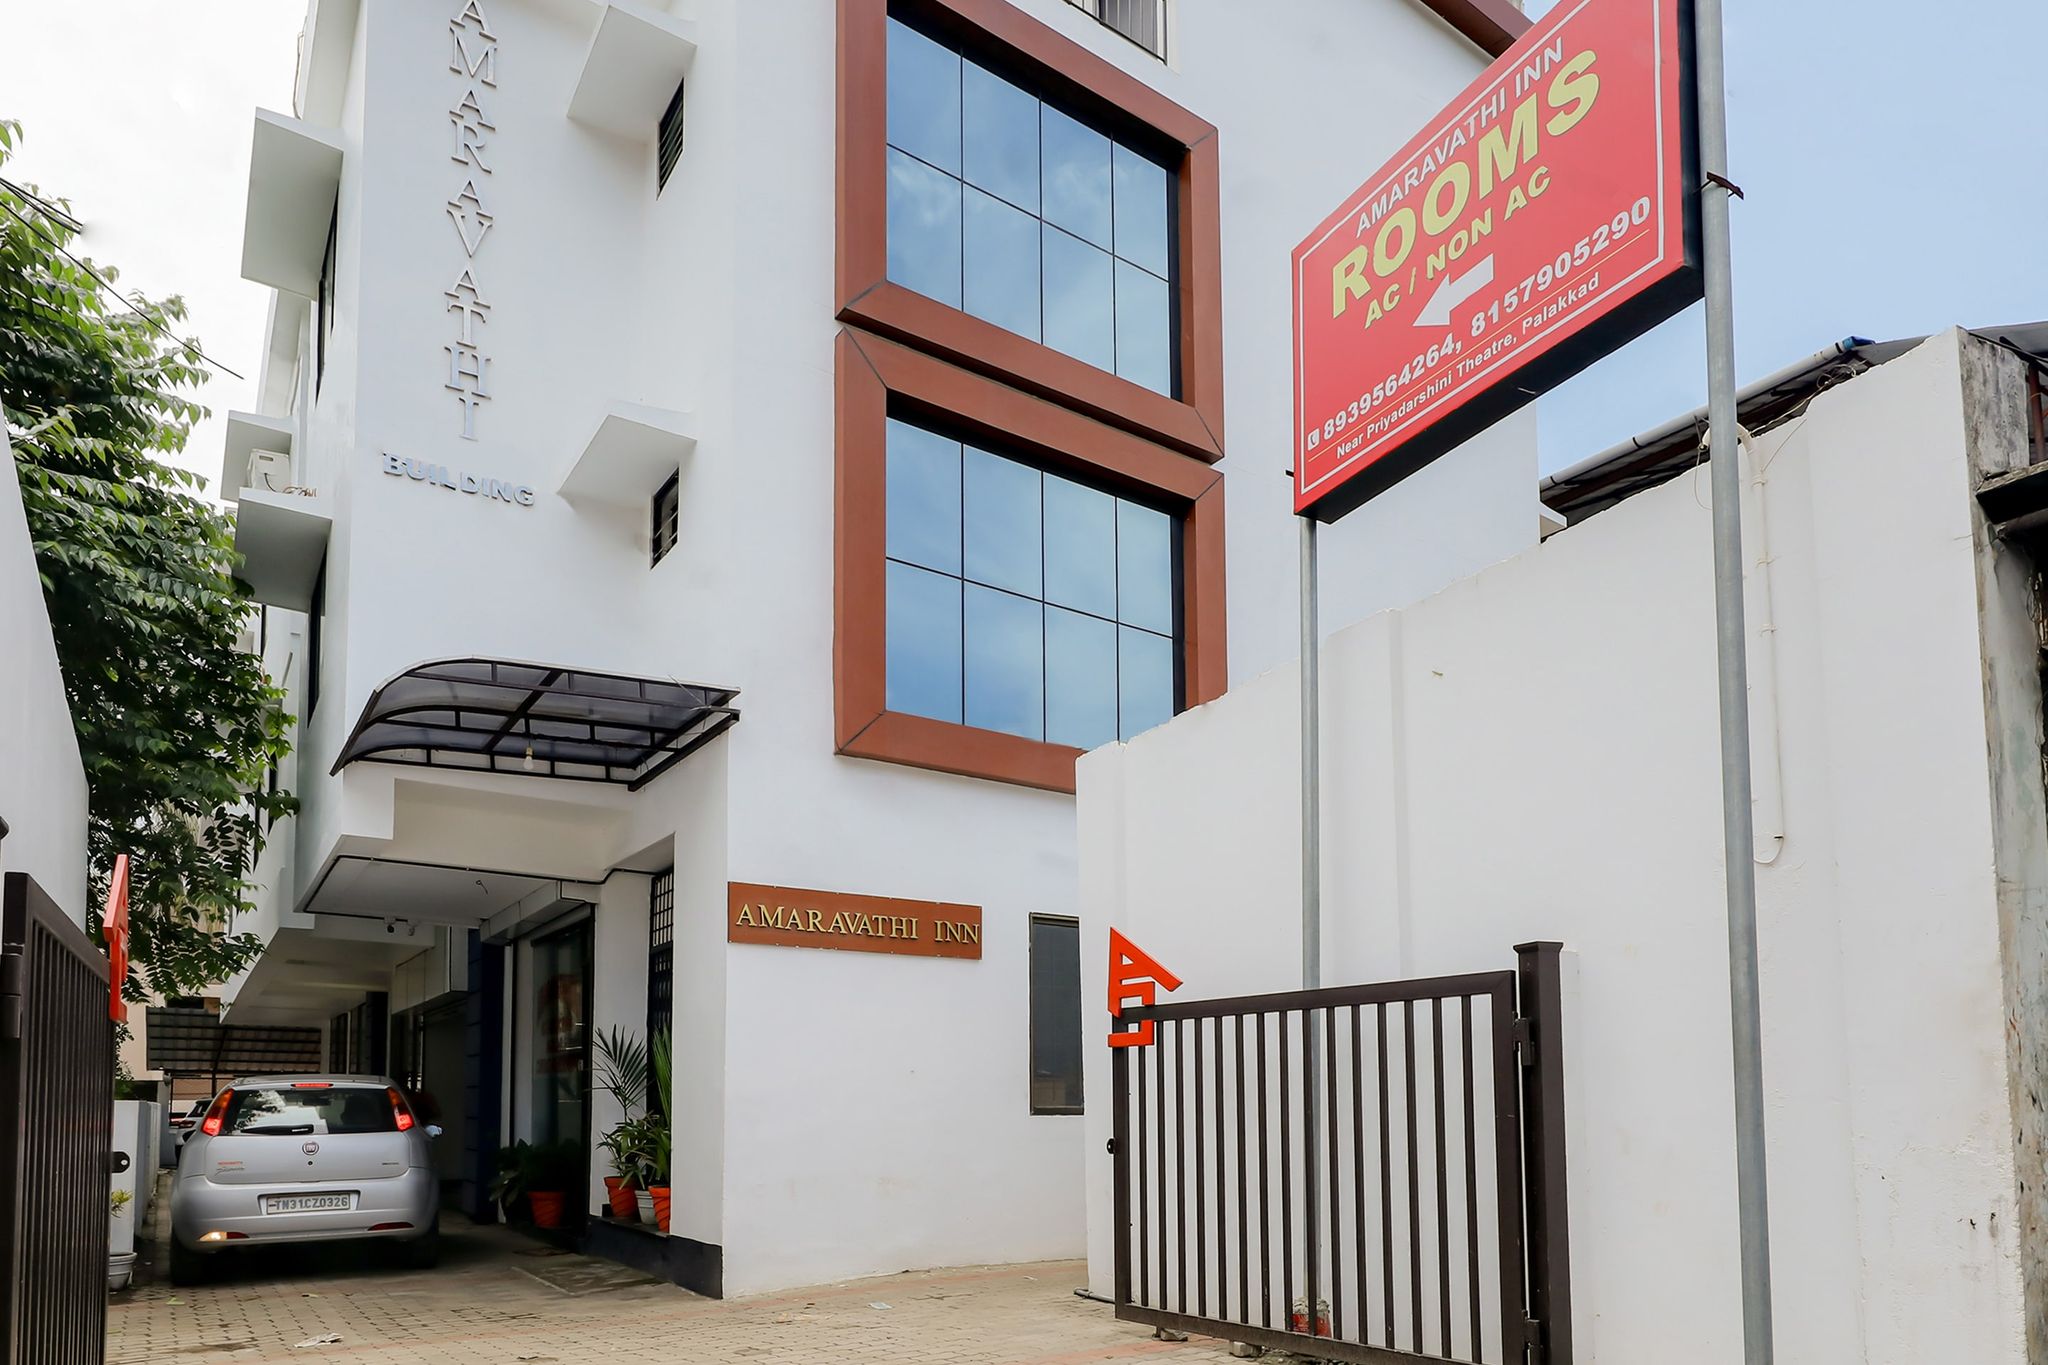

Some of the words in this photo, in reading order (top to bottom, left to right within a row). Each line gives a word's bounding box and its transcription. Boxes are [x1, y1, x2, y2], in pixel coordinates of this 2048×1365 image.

[444, 0, 497, 441] AMARAVATHI
[1332, 49, 1600, 318] ROOMS
[1356, 86, 1506, 238] AMARAVATHI
[1515, 36, 1563, 98] INN
[1324, 333, 1462, 441] 8939564264,
[1471, 196, 1651, 337] 8157905290
[1364, 283, 1401, 328] AC
[1409, 267, 1416, 295] /
[1426, 208, 1493, 280] NON
[1504, 166, 1551, 221] AC
[1337, 437, 1363, 459] Near
[1367, 371, 1453, 442] Priyadarshini
[1457, 333, 1518, 378] Theatre,
[1522, 272, 1600, 334] Palakkad
[382, 452, 535, 506] BUILDING
[736, 903, 918, 940] AMARAVATHI
[934, 920, 980, 944] INN
